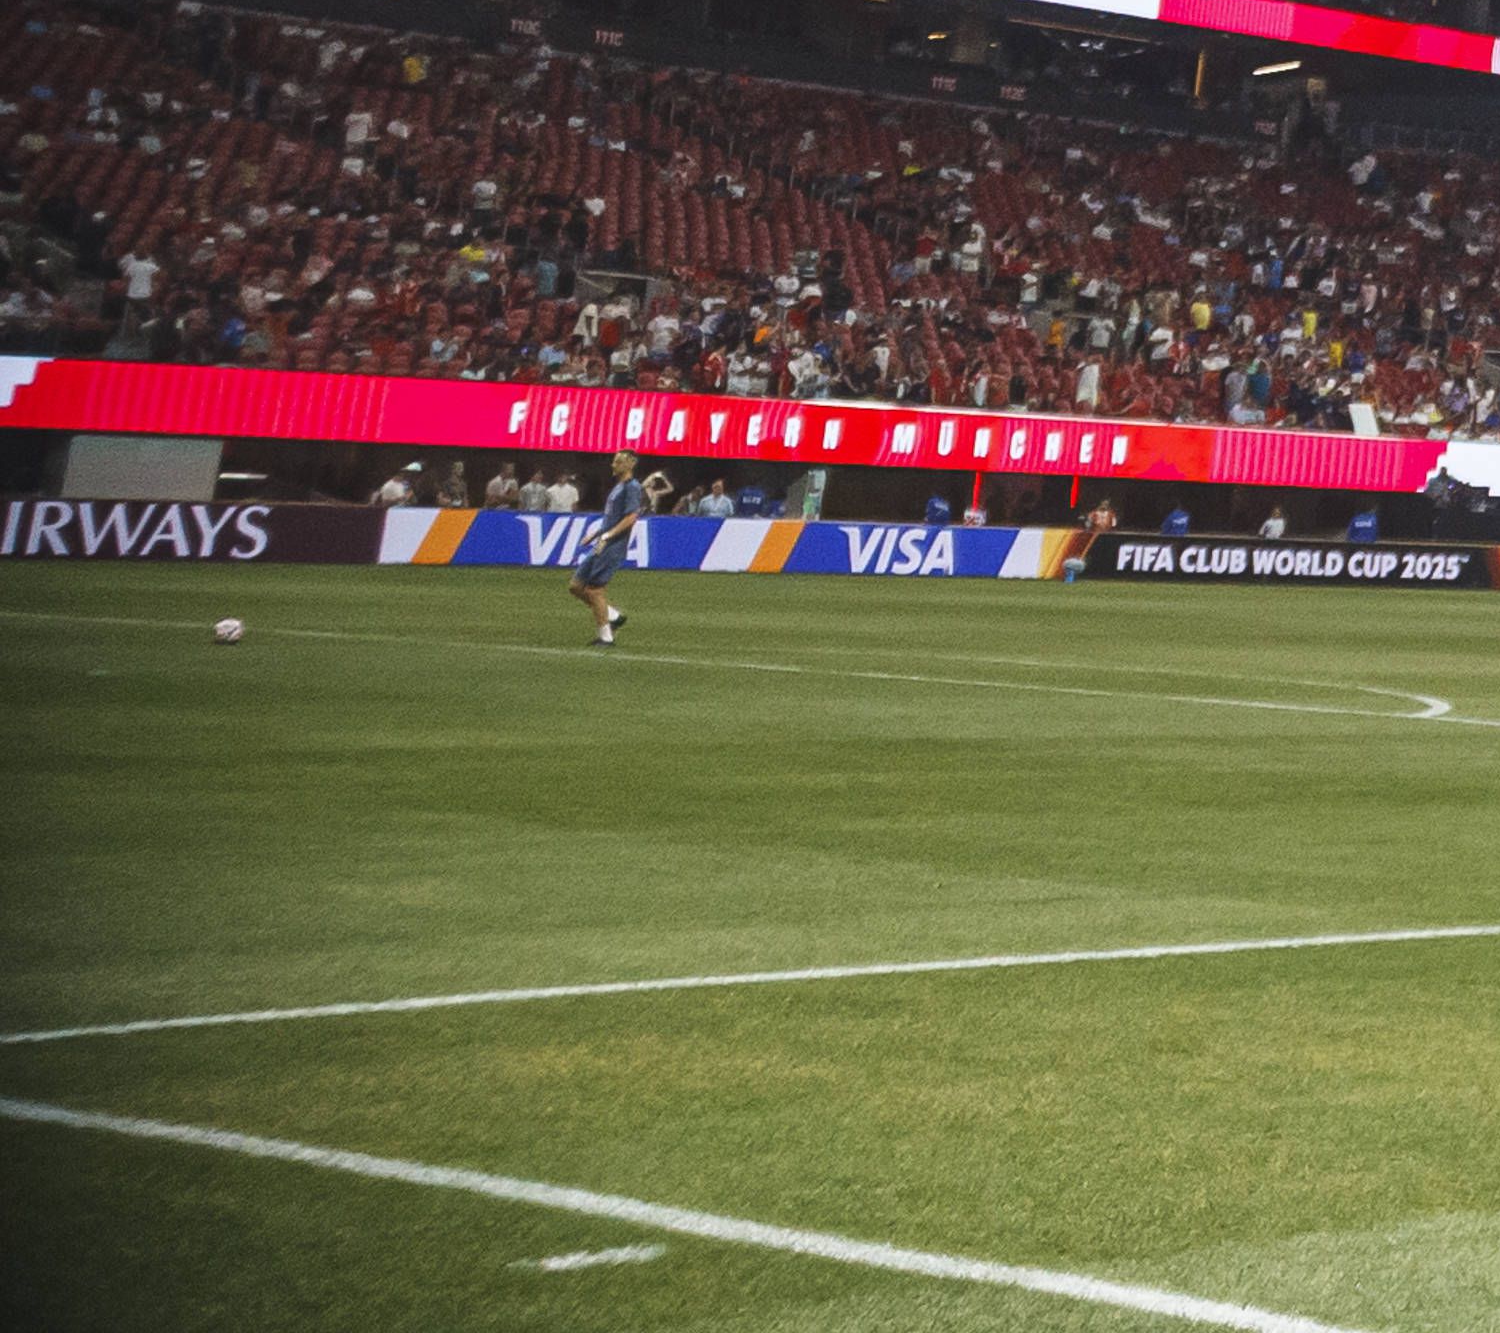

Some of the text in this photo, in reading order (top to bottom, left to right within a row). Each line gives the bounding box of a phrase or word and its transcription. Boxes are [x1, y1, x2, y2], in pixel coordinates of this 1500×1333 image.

[507, 401, 1130, 465] FC BAYERN MÜNCHEN
[837, 525, 956, 576] VISA
[1116, 544, 1175, 573] FIFA
[1179, 546, 1248, 576] CLUB
[1252, 548, 1344, 579] WORLD
[1347, 552, 1397, 580] CUP
